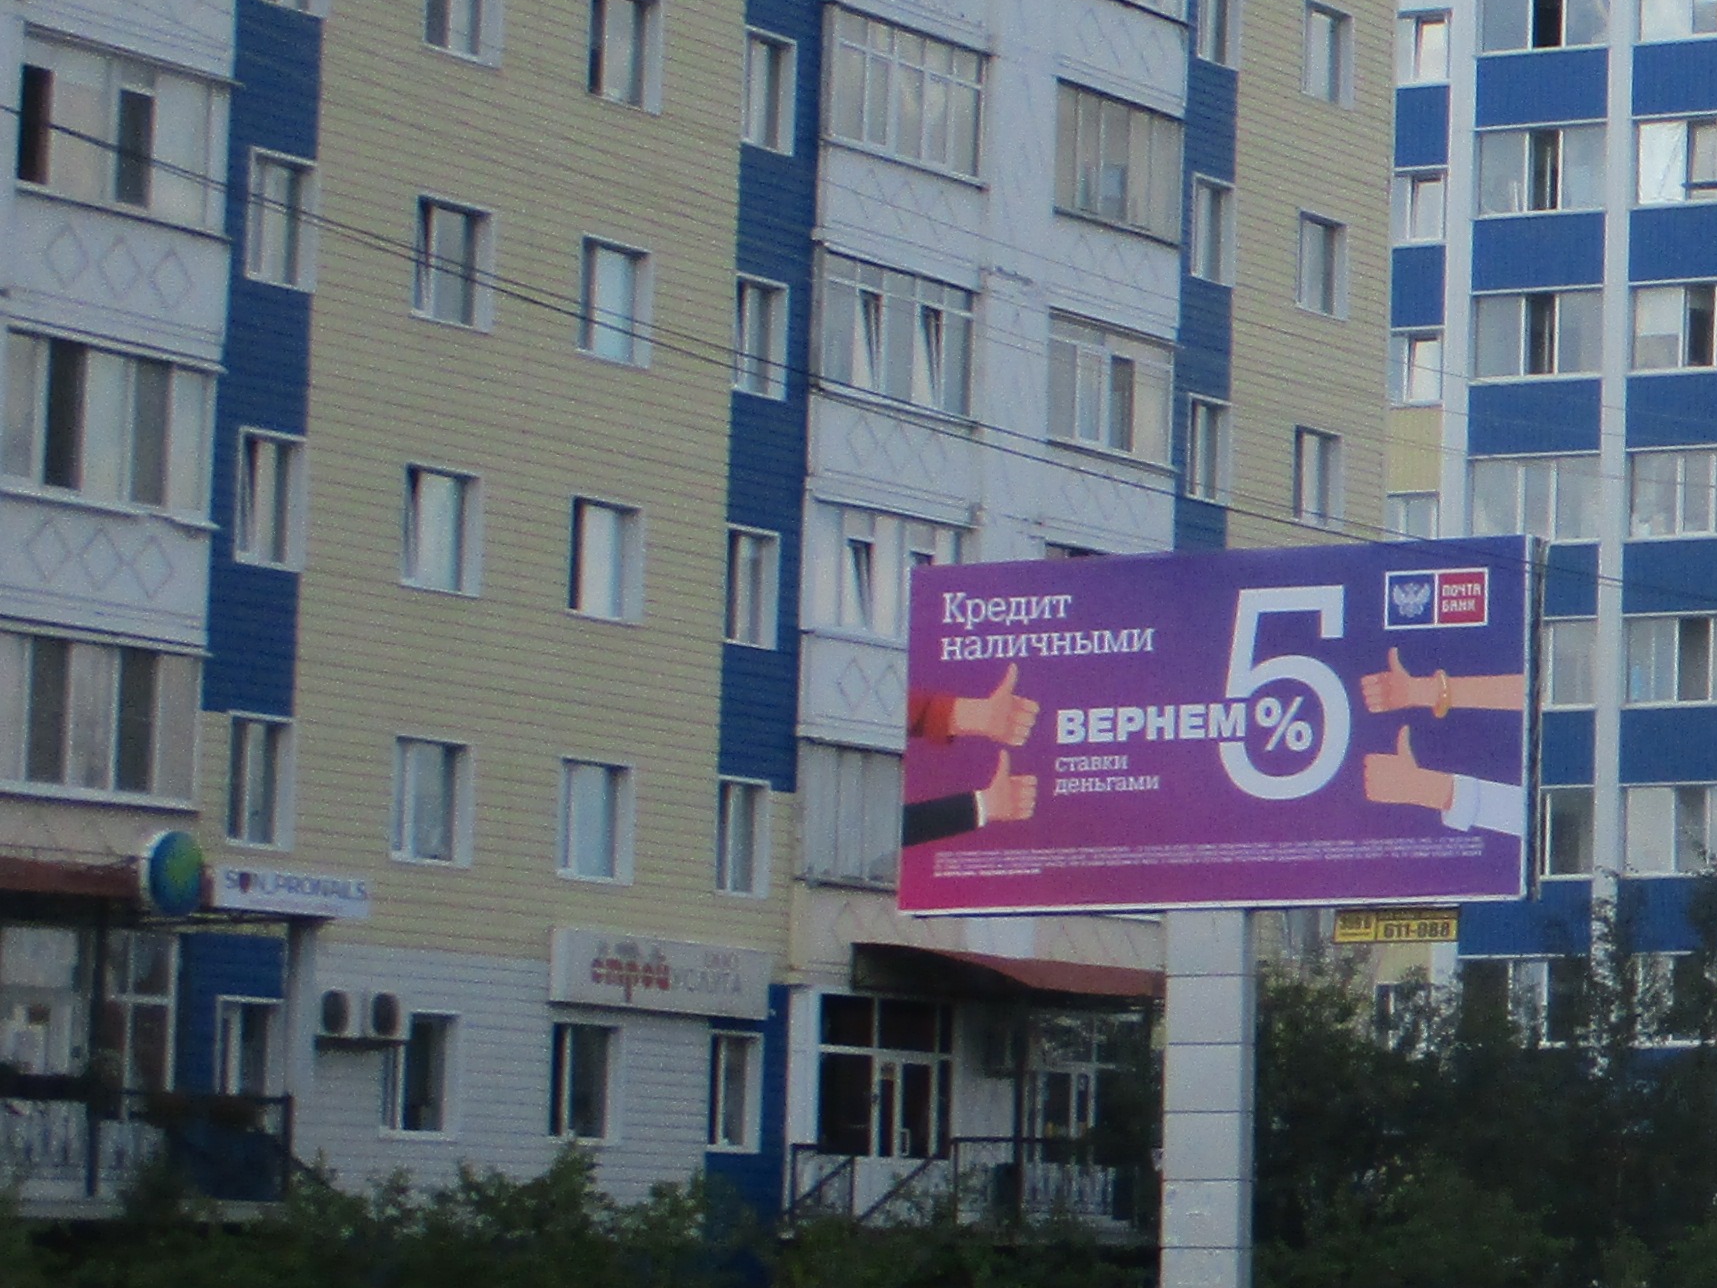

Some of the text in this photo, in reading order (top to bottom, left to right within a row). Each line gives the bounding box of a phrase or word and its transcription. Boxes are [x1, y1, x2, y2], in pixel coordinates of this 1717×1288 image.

[1442, 583, 1482, 598] ПОЧТА
[942, 591, 1073, 629] Кредит
[1441, 599, 1476, 613] БАНК
[940, 627, 1156, 661] наличными
[1056, 702, 1247, 745] ВЕРНЕМ
[1054, 755, 1129, 773] ставки
[1053, 775, 1160, 797] деньгами
